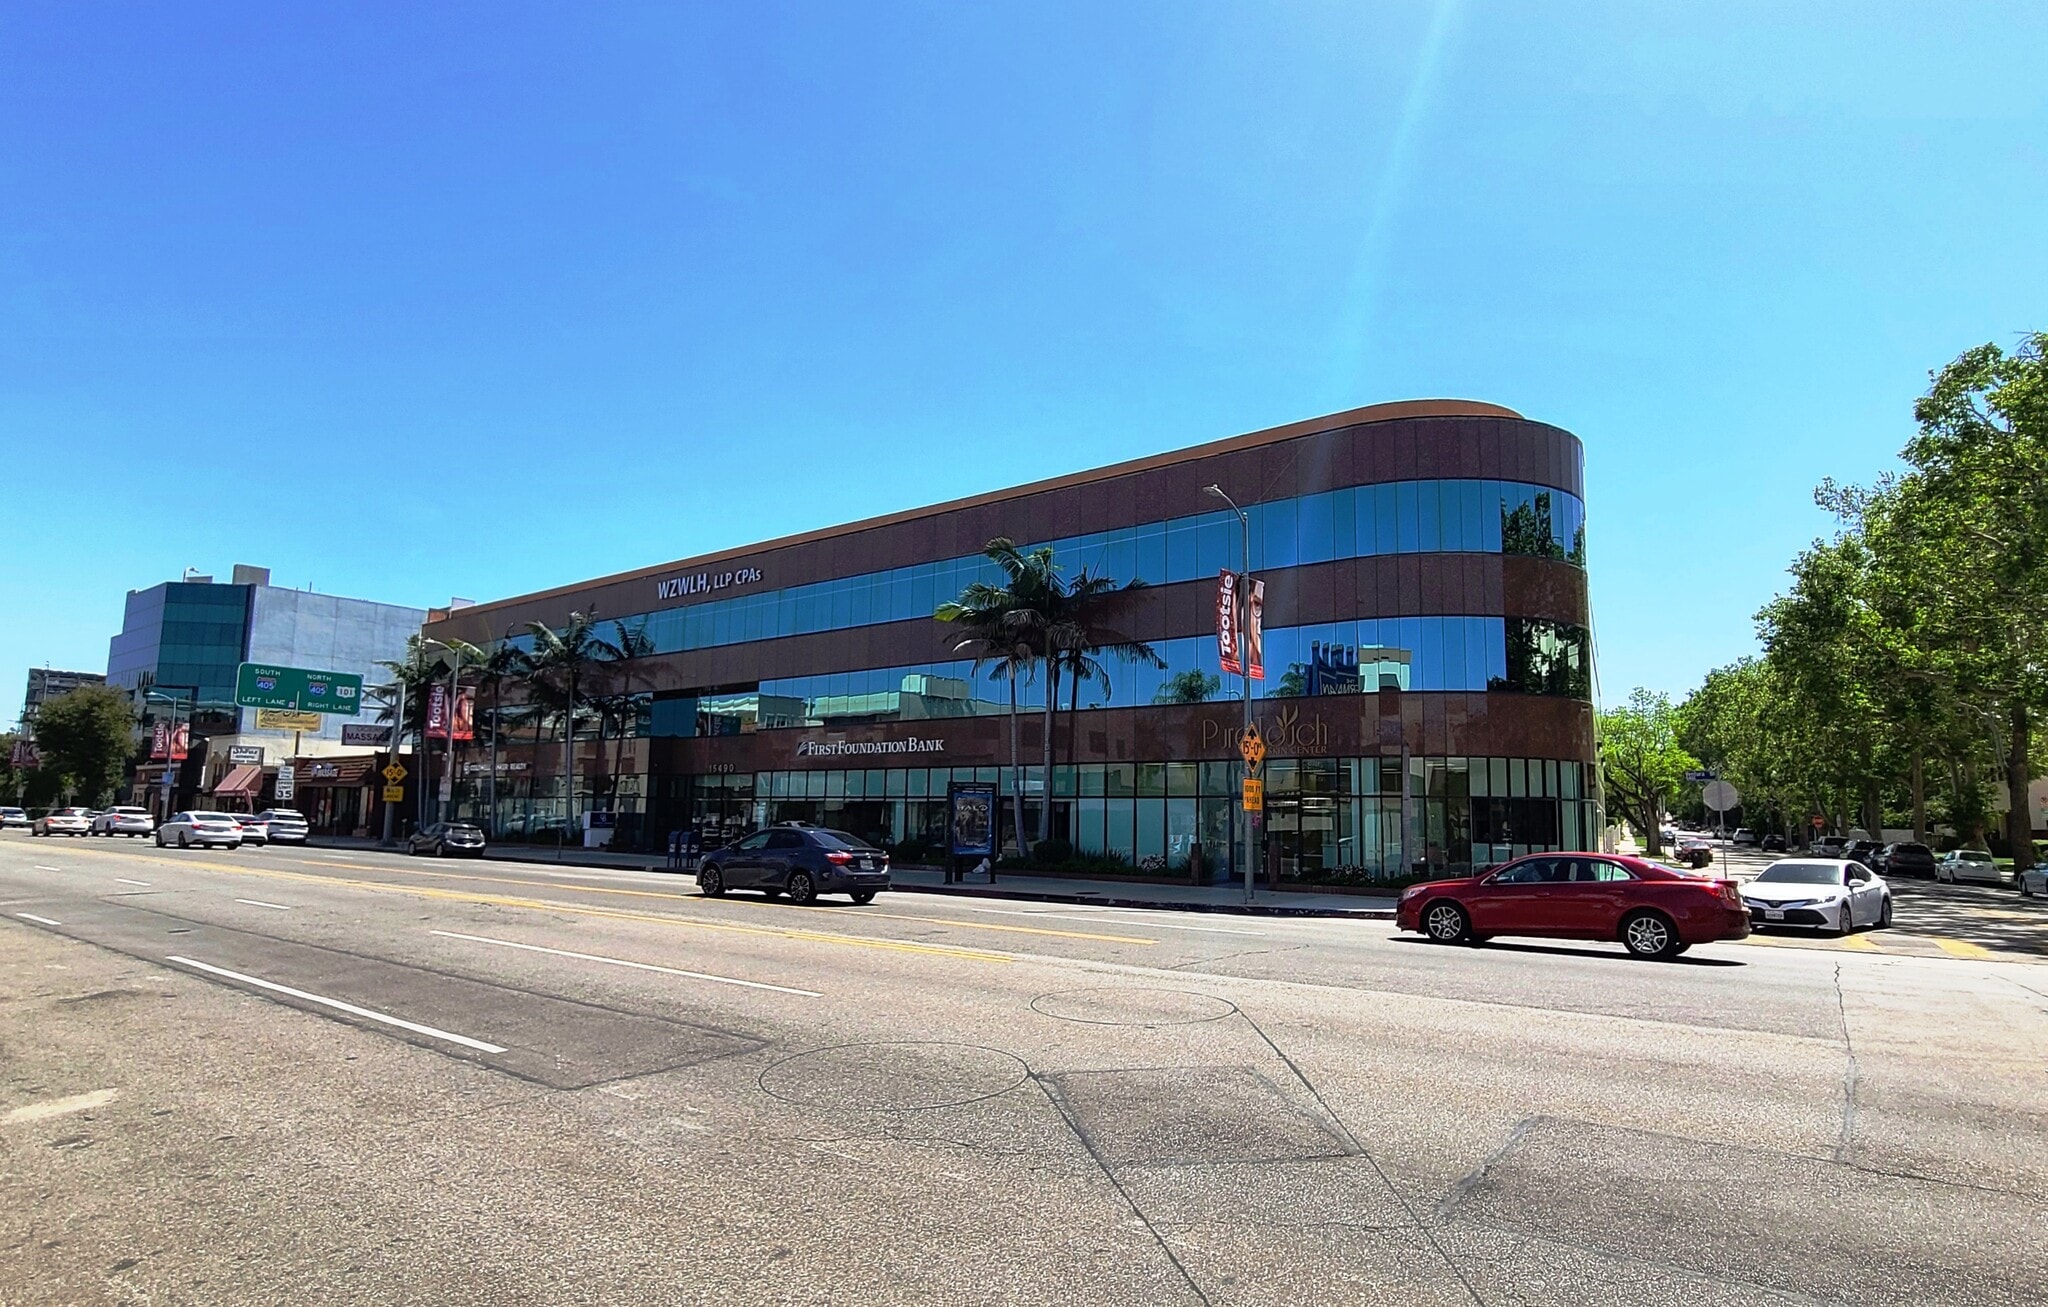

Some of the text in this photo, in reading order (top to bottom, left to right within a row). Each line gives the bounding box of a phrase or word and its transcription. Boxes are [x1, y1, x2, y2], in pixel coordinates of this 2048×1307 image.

[658, 568, 761, 600] WZWLH, LLP CPAs
[1219, 574, 1234, 656] Tootsie
[254, 668, 281, 677] SOUTH
[257, 681, 275, 690] 405
[309, 684, 328, 694] 405
[339, 687, 354, 697] 101
[241, 695, 286, 706] LEFT LANE
[307, 701, 330, 709] RIGHT
[430, 685, 445, 729] Tootsie
[808, 737, 945, 756] FIRST FOUNDATION BANK
[1291, 745, 1328, 754] CENTER
[277, 790, 292, 798] 35
